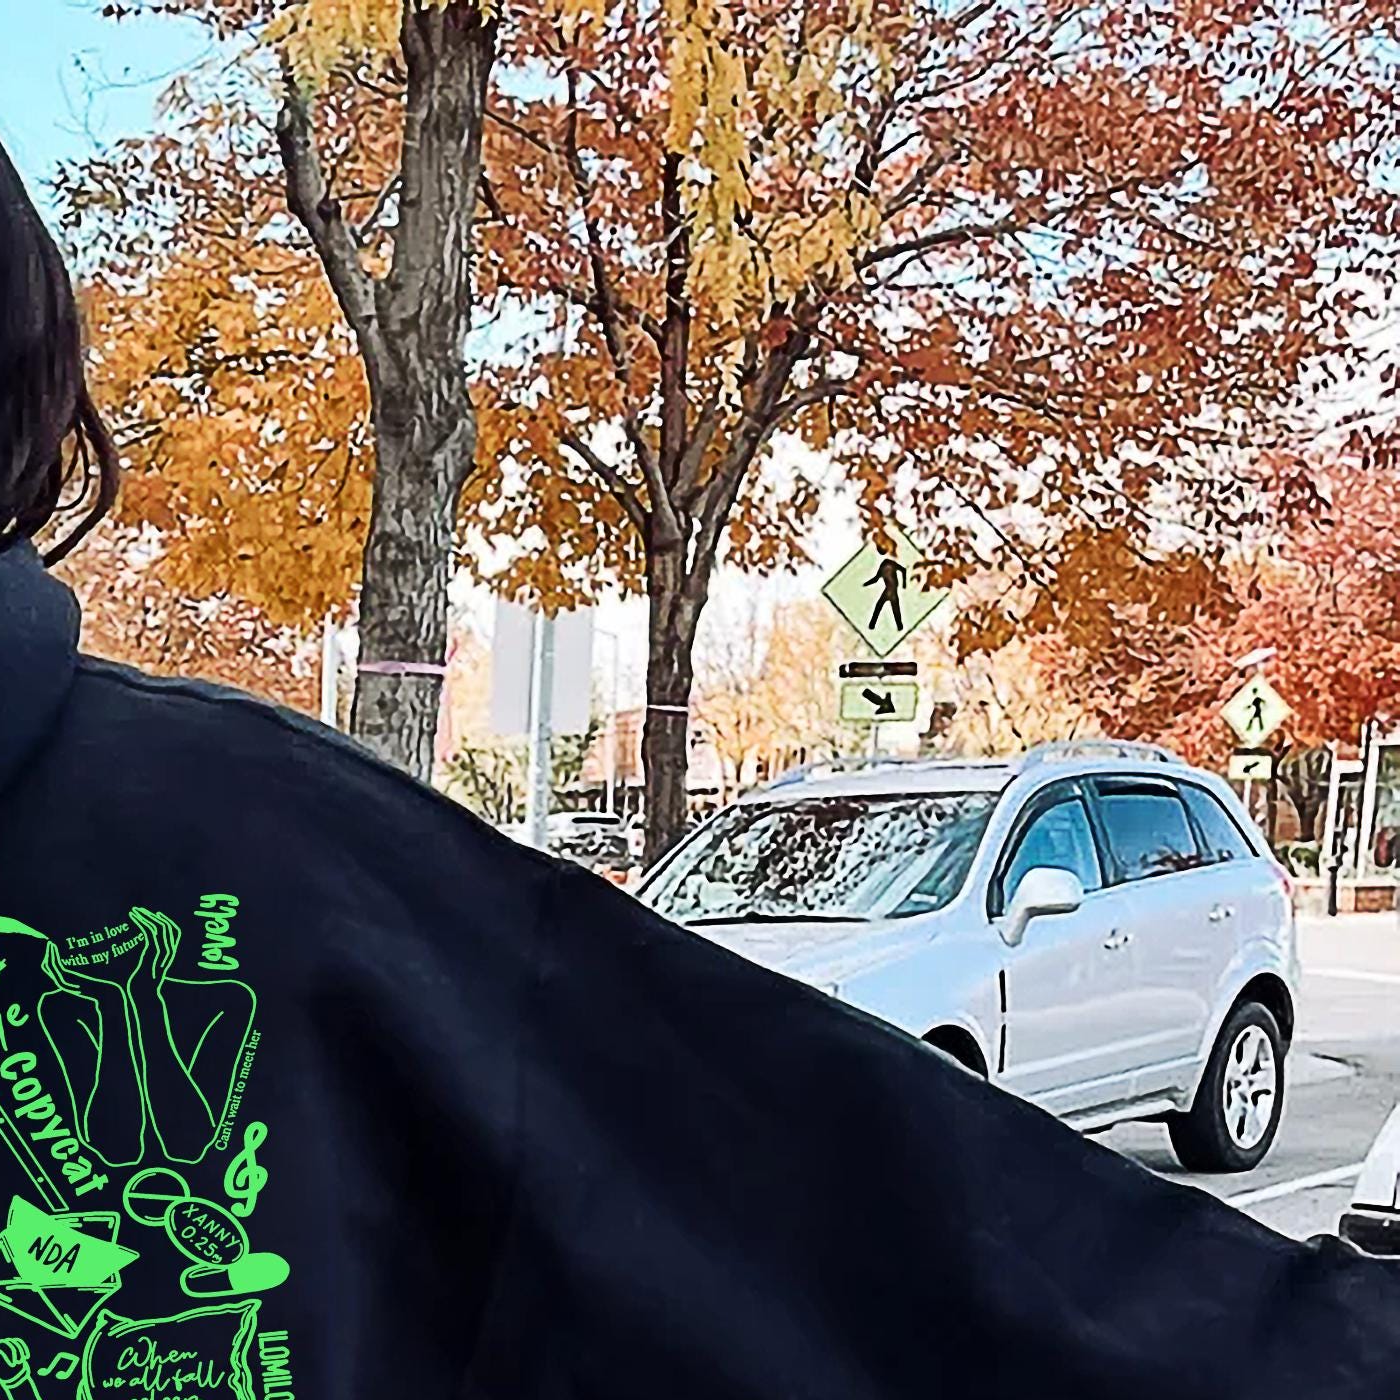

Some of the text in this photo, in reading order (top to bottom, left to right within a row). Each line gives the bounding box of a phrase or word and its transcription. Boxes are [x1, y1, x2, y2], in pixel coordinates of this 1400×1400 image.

[61, 933, 145, 966] with my future
[66, 923, 129, 949] I'm in love
[215, 1029, 262, 1151] Can't wait to meet her
[182, 1203, 241, 1249] XANNY
[27, 1234, 81, 1274] NDA
[117, 1336, 198, 1371] When
[102, 1359, 226, 1392] we all fall
